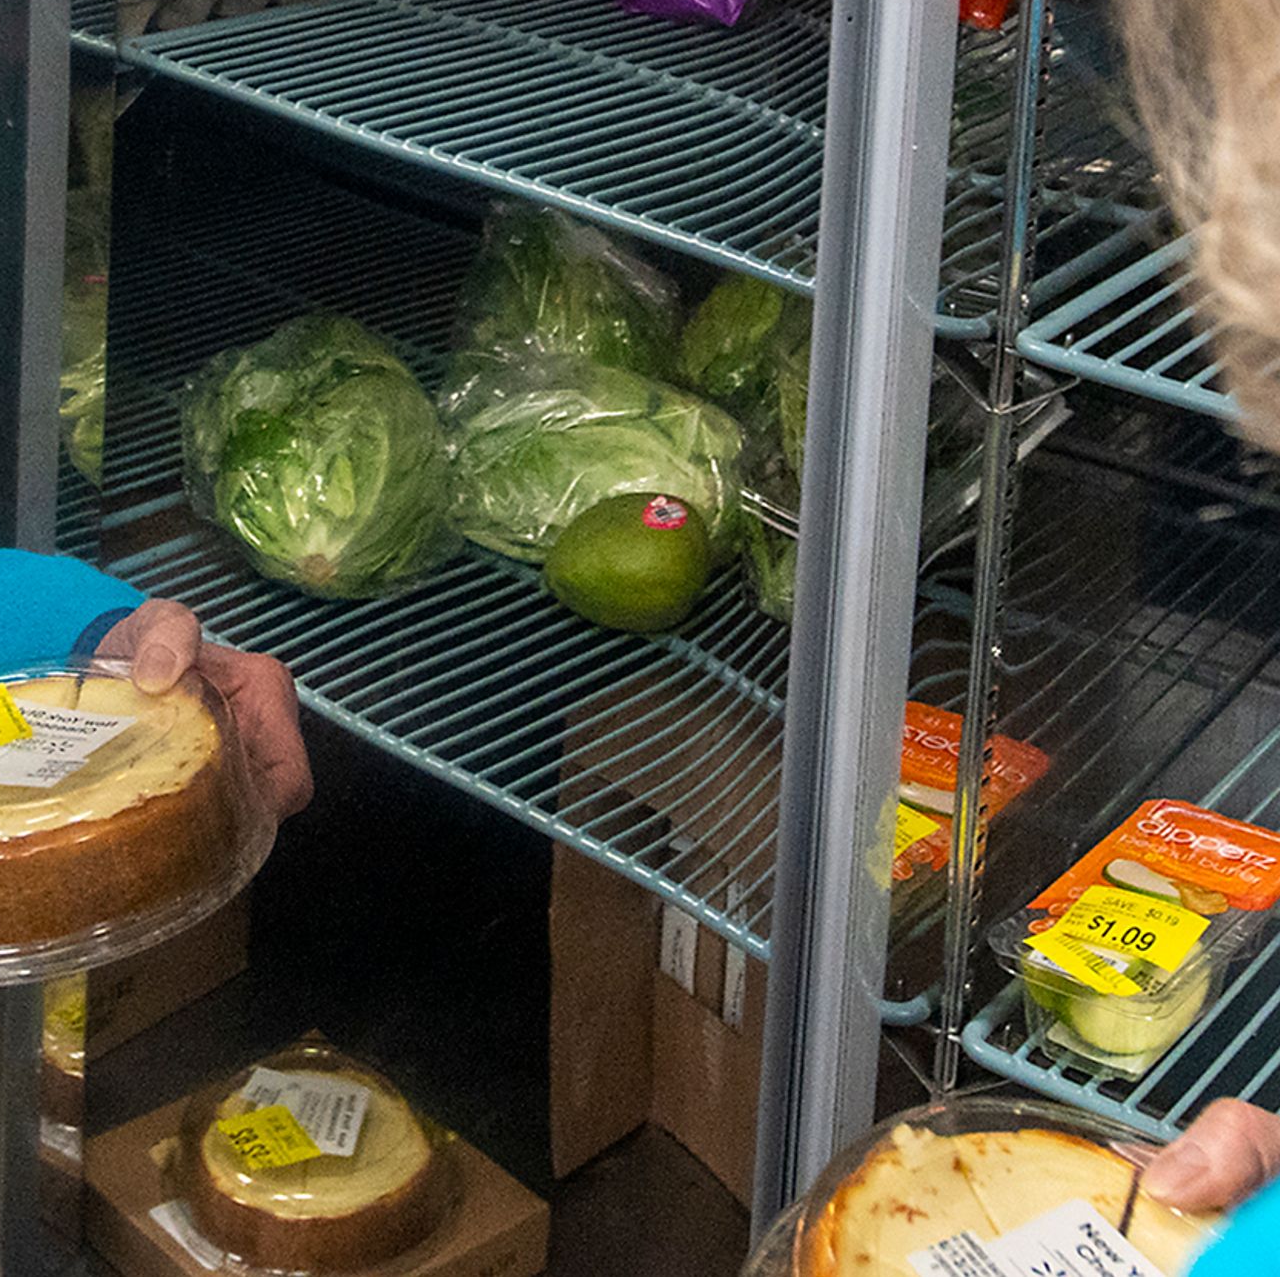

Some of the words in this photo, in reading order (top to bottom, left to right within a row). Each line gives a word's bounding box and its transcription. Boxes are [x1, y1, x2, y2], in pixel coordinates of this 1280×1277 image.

[1113, 834, 1196, 862] peanut
[1200, 856, 1262, 885] butter
[1136, 816, 1278, 871] dipperz
[1102, 895, 1137, 913] SAVE
[1145, 908, 1180, 928] $0.19
[1087, 914, 1157, 952] $1.09
[1079, 1222, 1124, 1264] New
